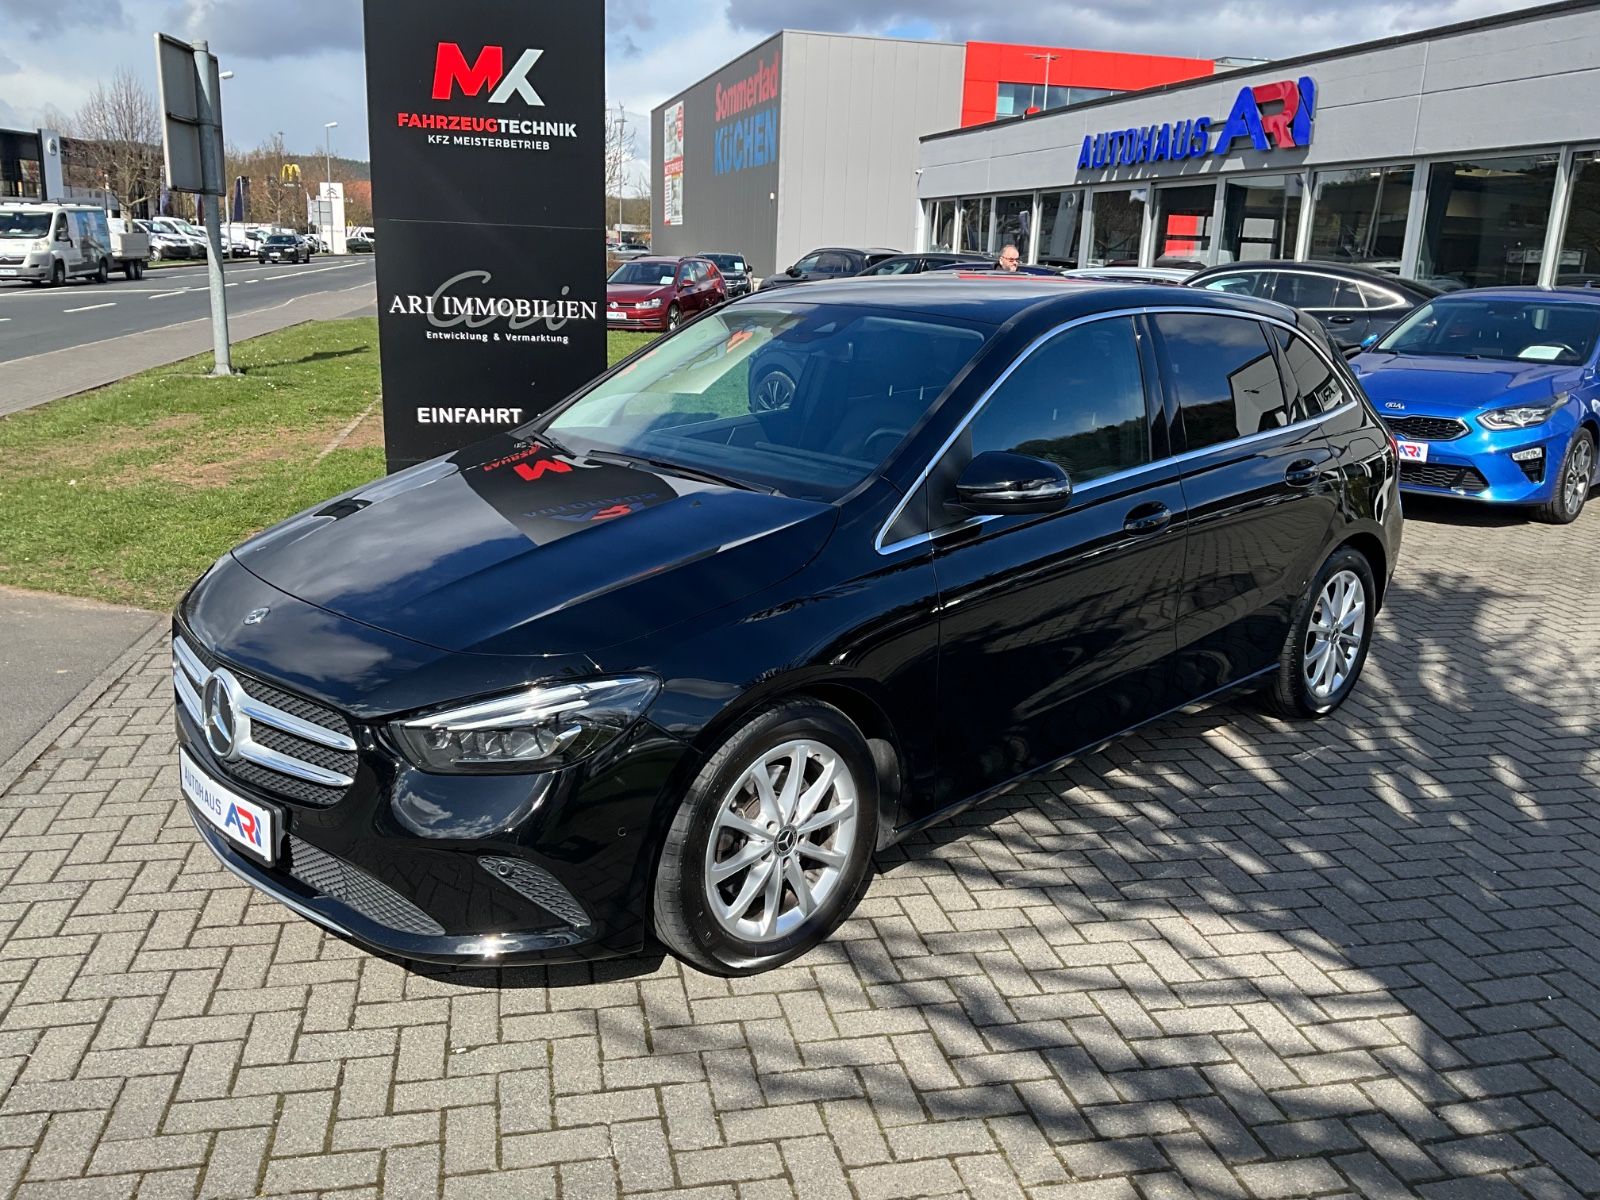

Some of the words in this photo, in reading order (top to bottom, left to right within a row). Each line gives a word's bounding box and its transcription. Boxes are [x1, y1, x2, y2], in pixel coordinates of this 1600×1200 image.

[432, 42, 545, 107] MK
[715, 51, 780, 122] Sommerlad
[397, 113, 577, 137] FAHRZEUGTECHNIK
[428, 134, 450, 146] KFZ
[453, 135, 550, 151] MEISTERBETRIEB
[714, 107, 777, 176] KÜCHEN
[1077, 116, 1212, 169] AUTOHAUS
[1214, 76, 1318, 156] ARI
[389, 295, 434, 315] ARI
[442, 295, 598, 320] IMMOBILIEN
[426, 331, 488, 342] Entwicklung
[493, 332, 501, 341] &
[505, 333, 569, 344] Vermarktung
[417, 407, 523, 424] EINFAHRT
[184, 766, 222, 816] AUTOHAUS
[224, 801, 262, 848] ARI
